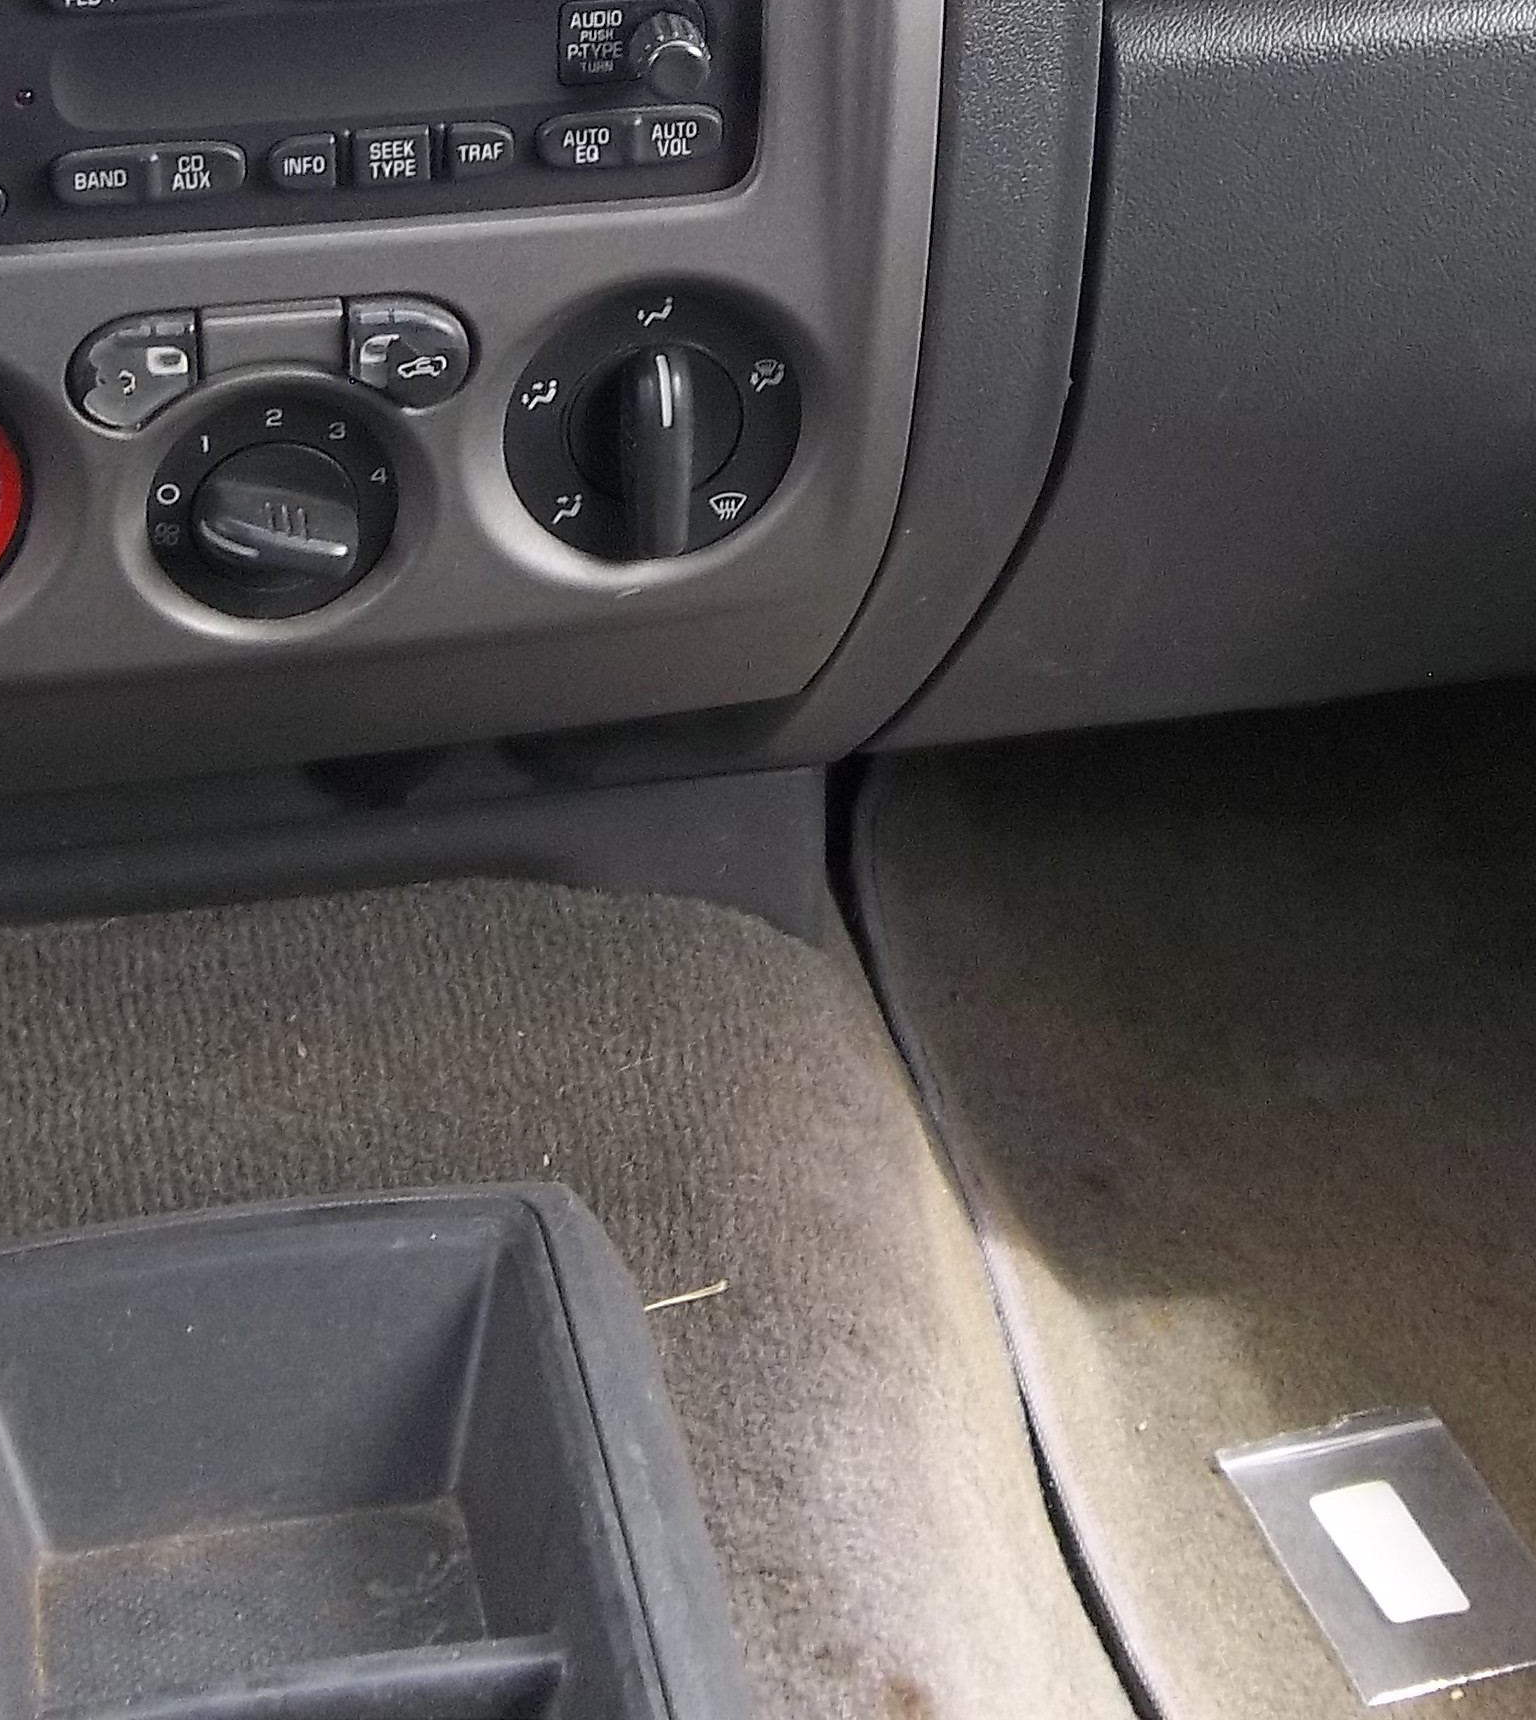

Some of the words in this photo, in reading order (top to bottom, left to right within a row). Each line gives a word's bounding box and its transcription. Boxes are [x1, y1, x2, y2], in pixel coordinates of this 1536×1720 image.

[569, 10, 623, 29] AUDIO
[579, 29, 614, 43] PUSH
[563, 128, 610, 148] AUTO
[651, 121, 698, 140] AUTO
[369, 140, 415, 161] SEEK
[456, 142, 504, 163] TRAF
[575, 145, 599, 164] EQ
[657, 138, 692, 157] VOL
[178, 155, 204, 173] CD
[284, 156, 326, 176] INFO
[369, 160, 416, 180] TYPE
[74, 169, 127, 190] BAND
[172, 170, 211, 191] AUX
[266, 408, 284, 428] 2
[329, 422, 347, 440] 3
[200, 435, 211, 453] 1
[370, 467, 387, 484] 4
